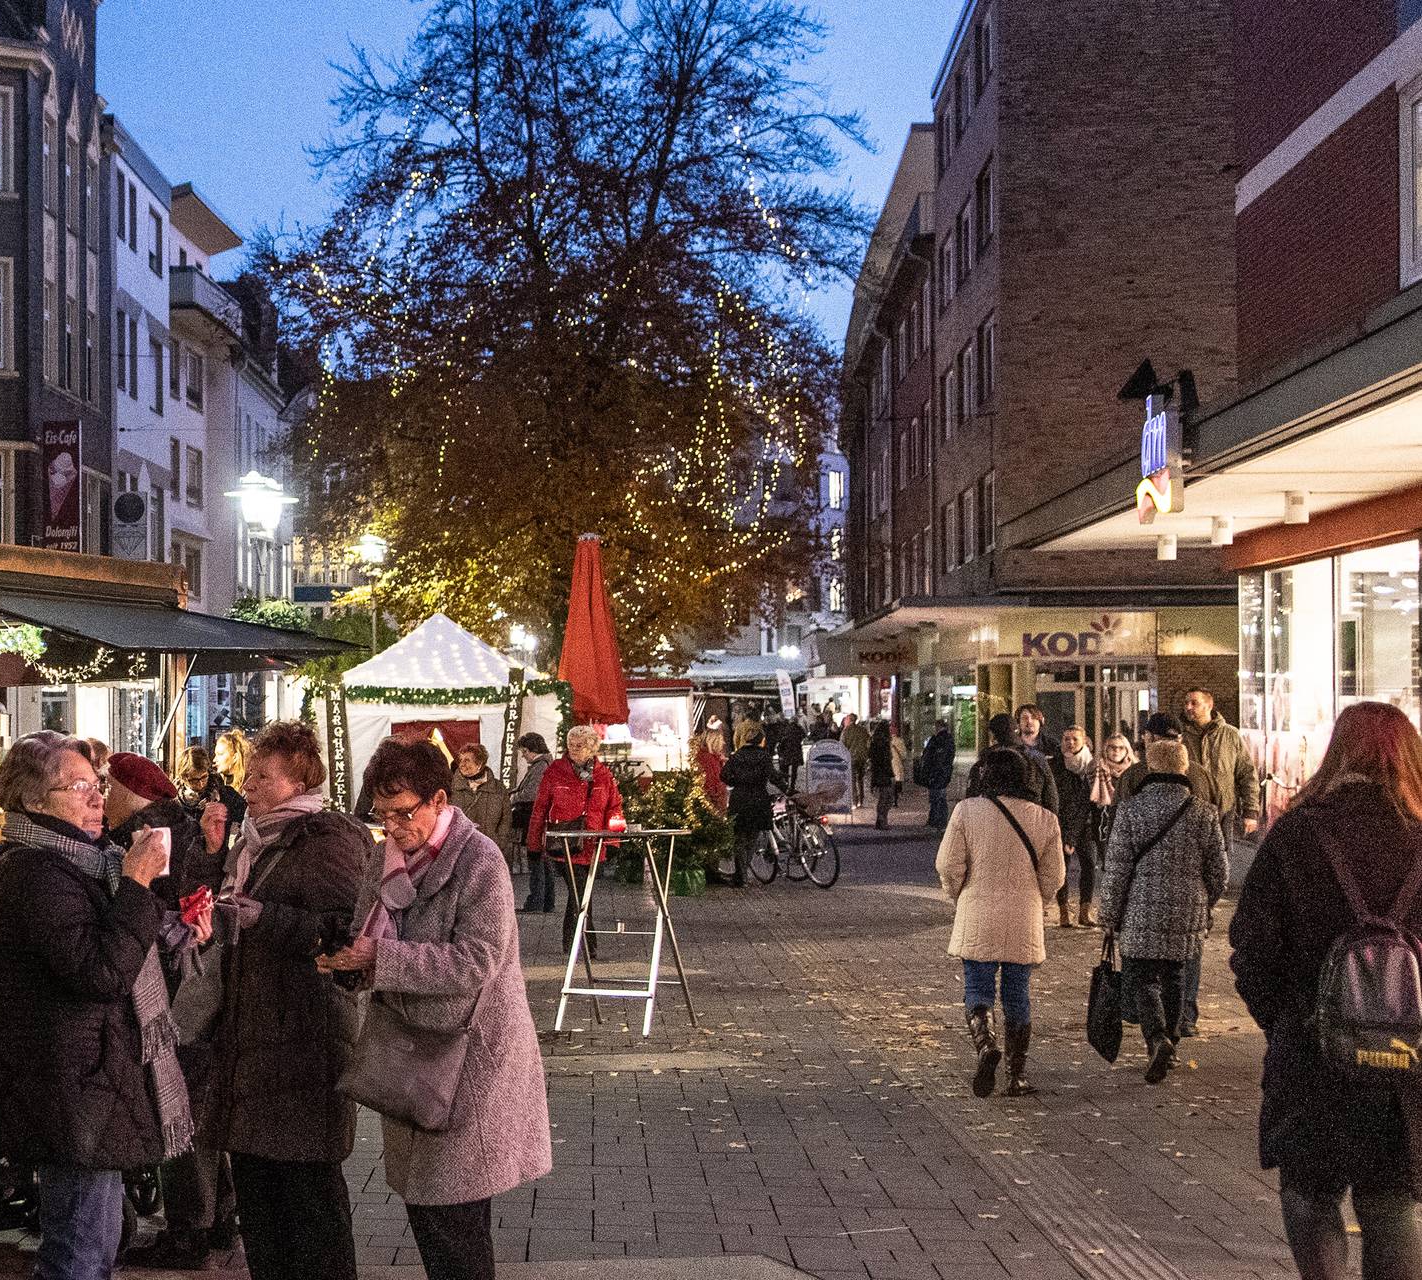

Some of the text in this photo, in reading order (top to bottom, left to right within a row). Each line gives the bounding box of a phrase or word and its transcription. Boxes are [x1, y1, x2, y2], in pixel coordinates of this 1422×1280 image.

[1141, 395, 1167, 479] dm
[45, 525, 78, 539] Dolomiti
[60, 541, 78, 551] 1952
[1356, 1049, 1410, 1069] PUMA
